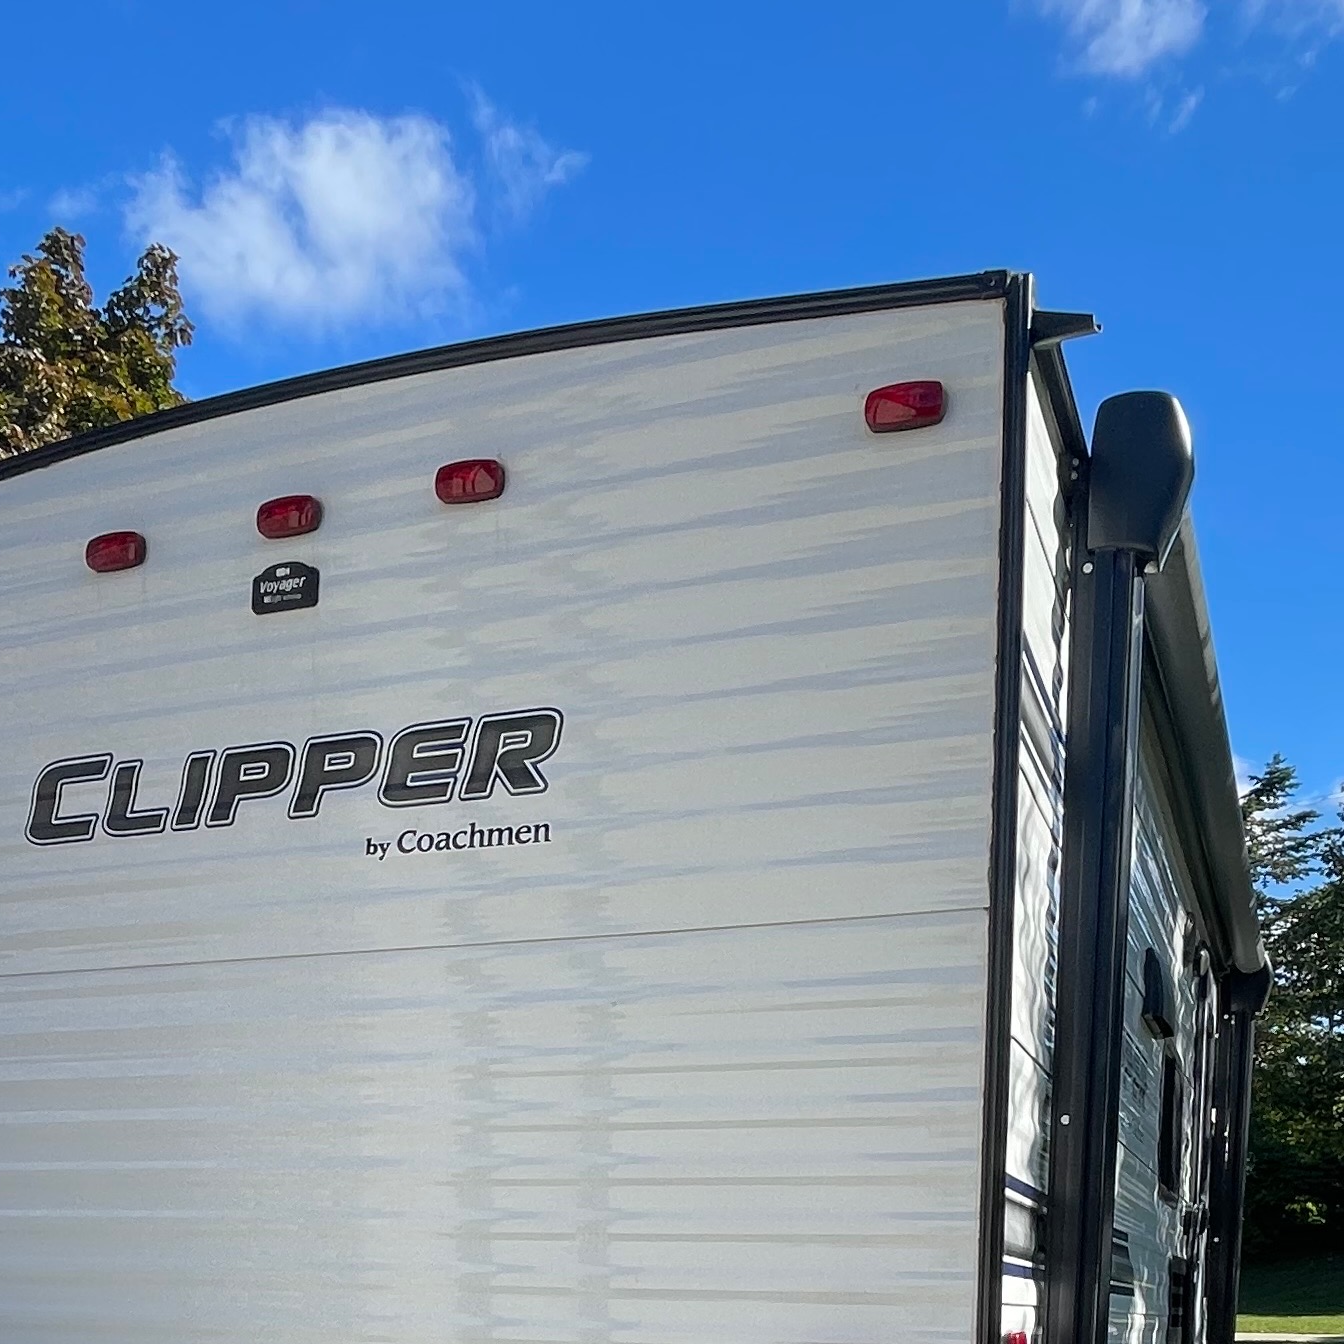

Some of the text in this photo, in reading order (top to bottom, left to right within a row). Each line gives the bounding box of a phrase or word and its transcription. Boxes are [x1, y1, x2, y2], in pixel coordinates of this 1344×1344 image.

[260, 576, 306, 594] Voyager
[24, 706, 564, 846] CLIPPER
[365, 820, 551, 861] by Coachmen
